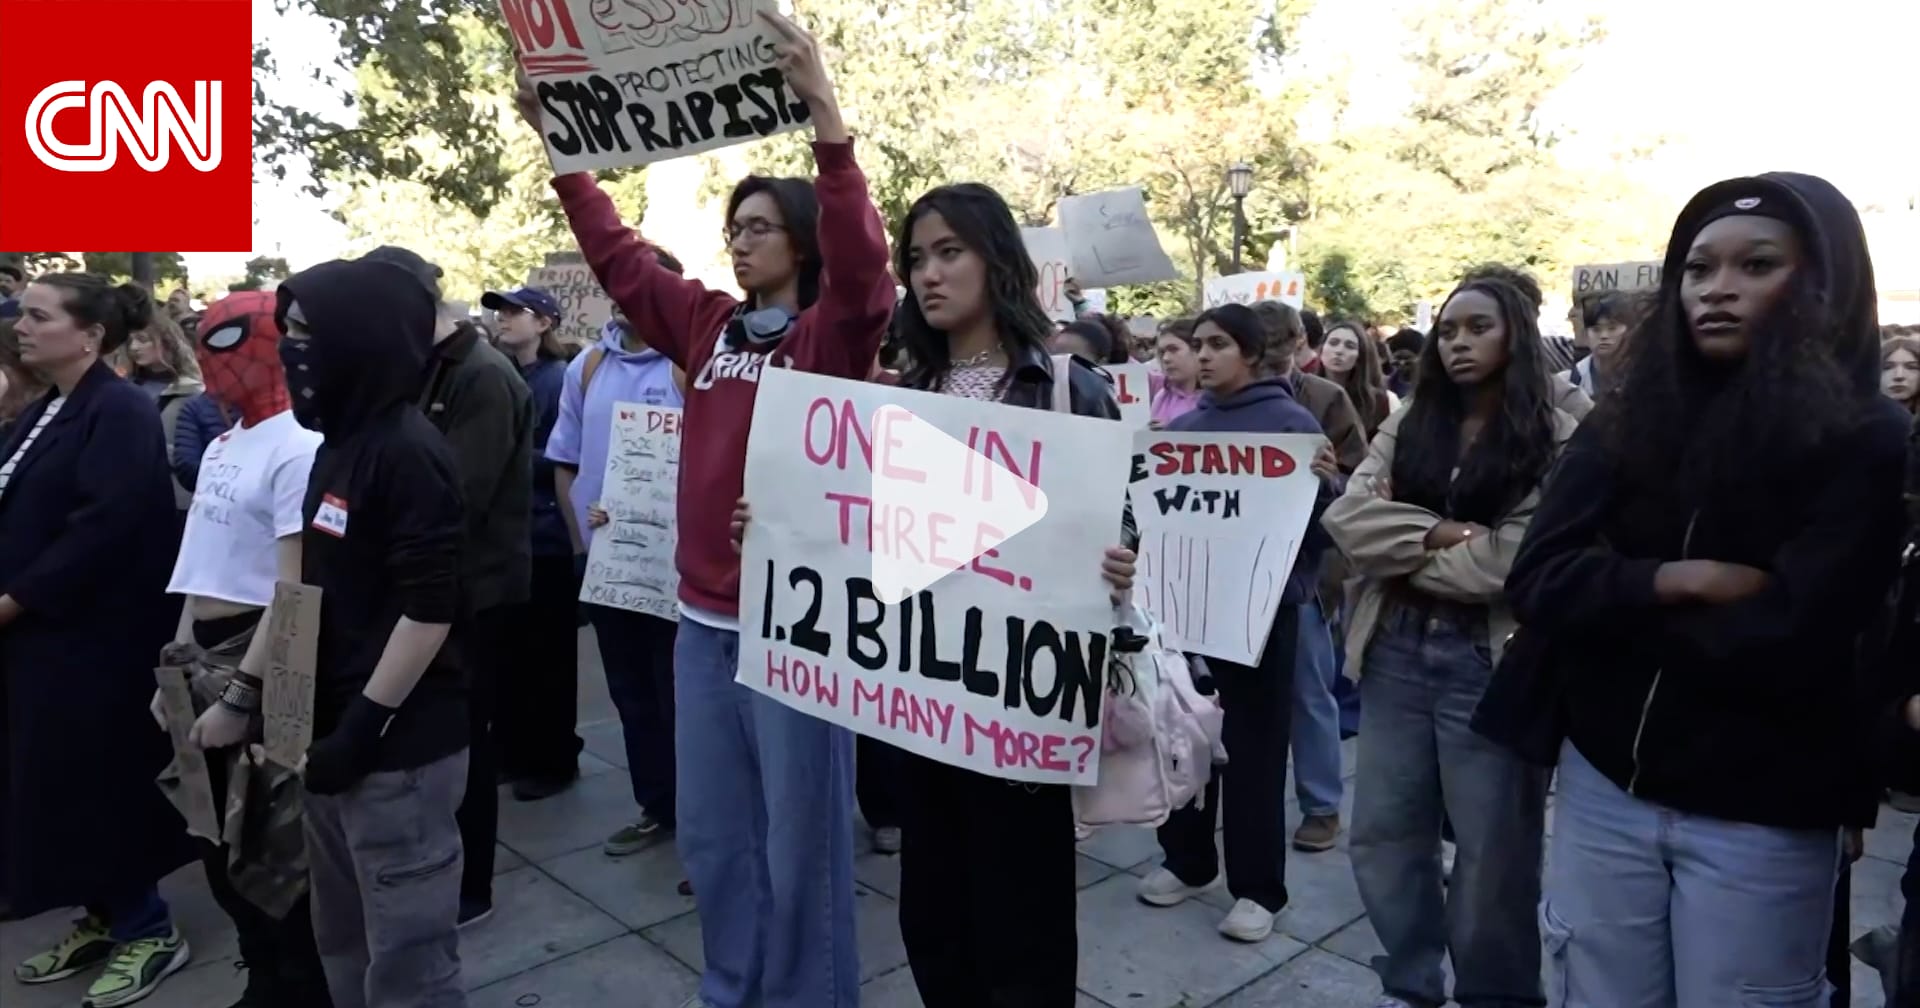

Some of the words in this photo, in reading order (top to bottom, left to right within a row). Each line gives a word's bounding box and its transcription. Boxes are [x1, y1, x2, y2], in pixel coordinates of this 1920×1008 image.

[614, 35, 779, 97] PROTECTING
[536, 75, 632, 156] STOP
[1578, 268, 1619, 291] BAN
[1636, 264, 1663, 287] FU
[803, 397, 927, 484] ONE
[964, 426, 1043, 510] IN
[1128, 453, 1149, 484] E
[1149, 441, 1297, 478] STAND
[825, 491, 1033, 591] THREE.
[761, 559, 831, 657] 1.2
[845, 577, 1107, 729] BILLION
[766, 649, 839, 707] HOW
[852, 678, 955, 745] MANY
[963, 712, 1096, 773] MORE?
